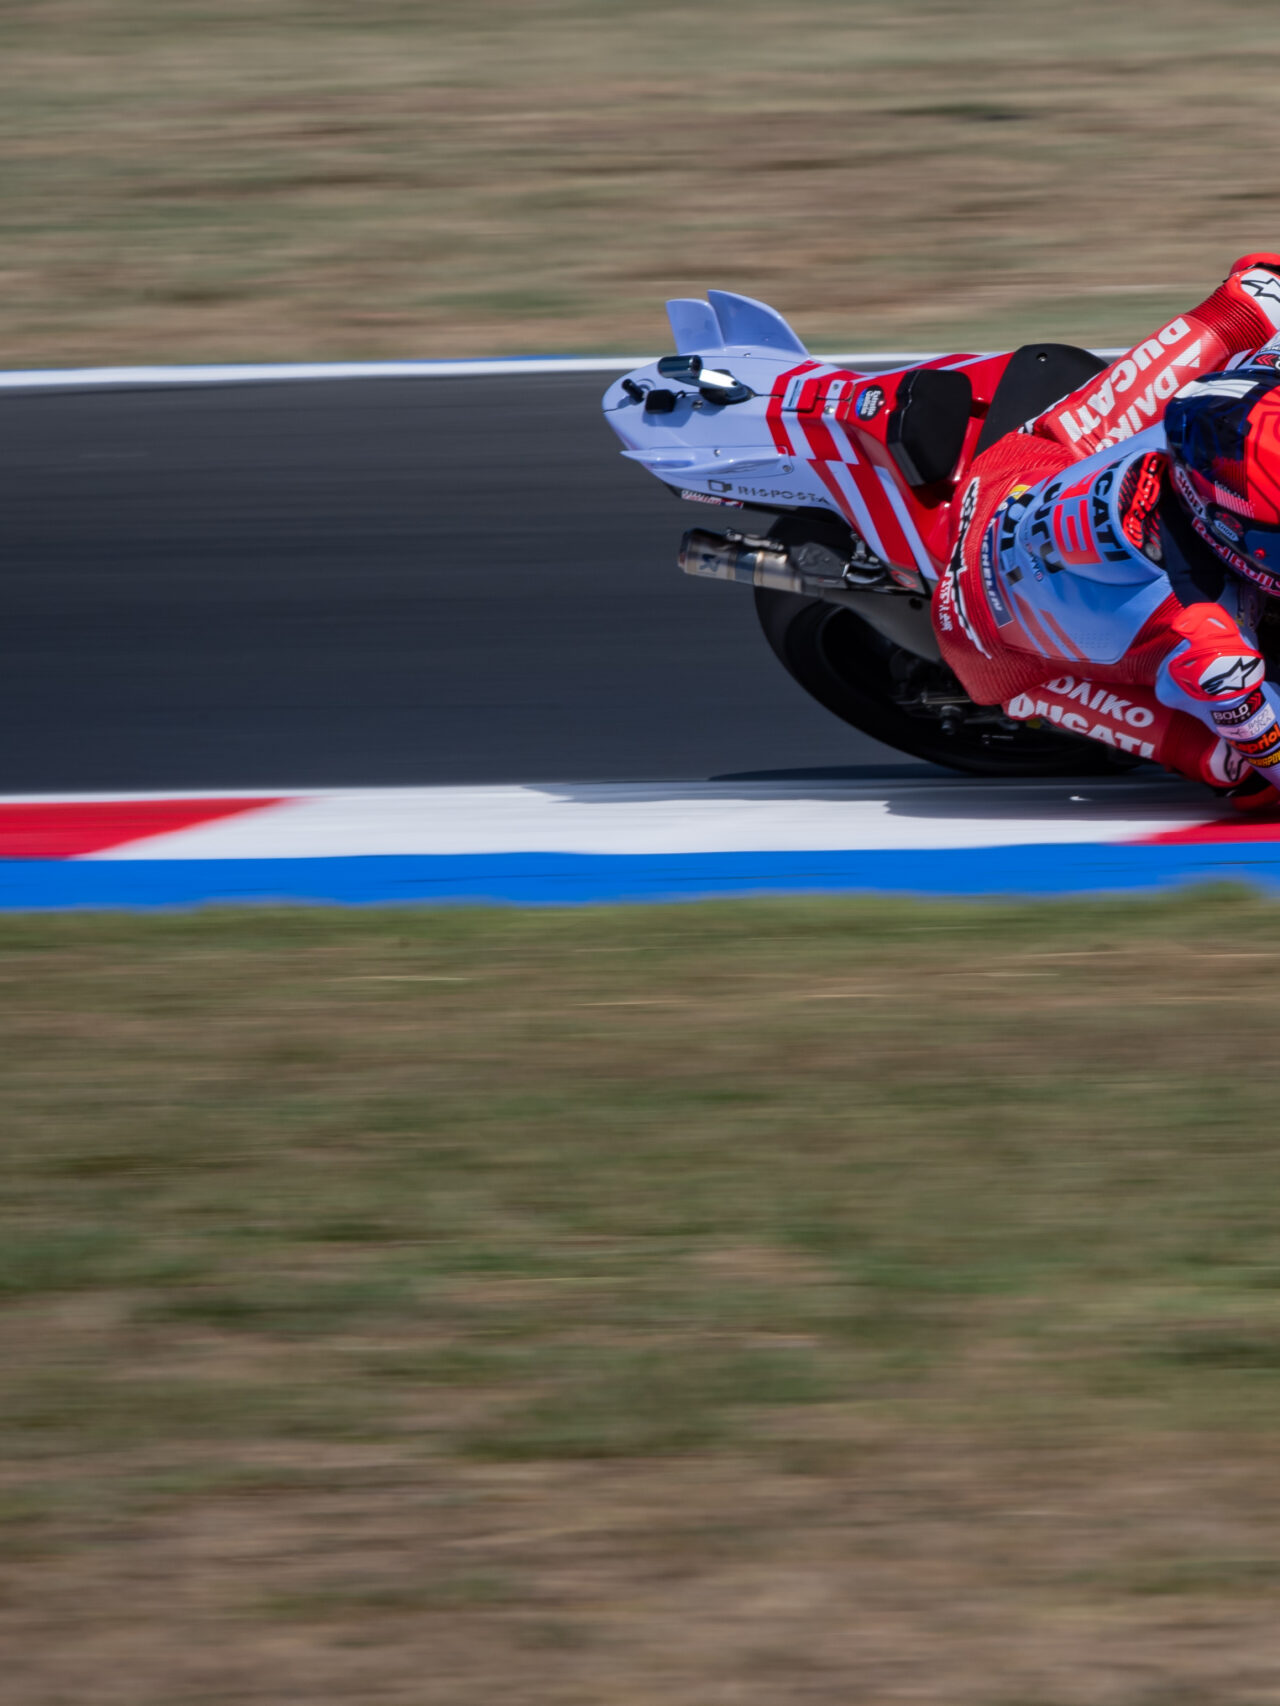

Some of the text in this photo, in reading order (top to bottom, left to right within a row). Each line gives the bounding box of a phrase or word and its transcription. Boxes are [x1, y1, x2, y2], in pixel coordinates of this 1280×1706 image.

[1058, 317, 1191, 443] DUCATI
[1192, 516, 1274, 588] Red Bull
[1008, 693, 1155, 759] DUCATI
[1213, 704, 1249, 720] BOLD
